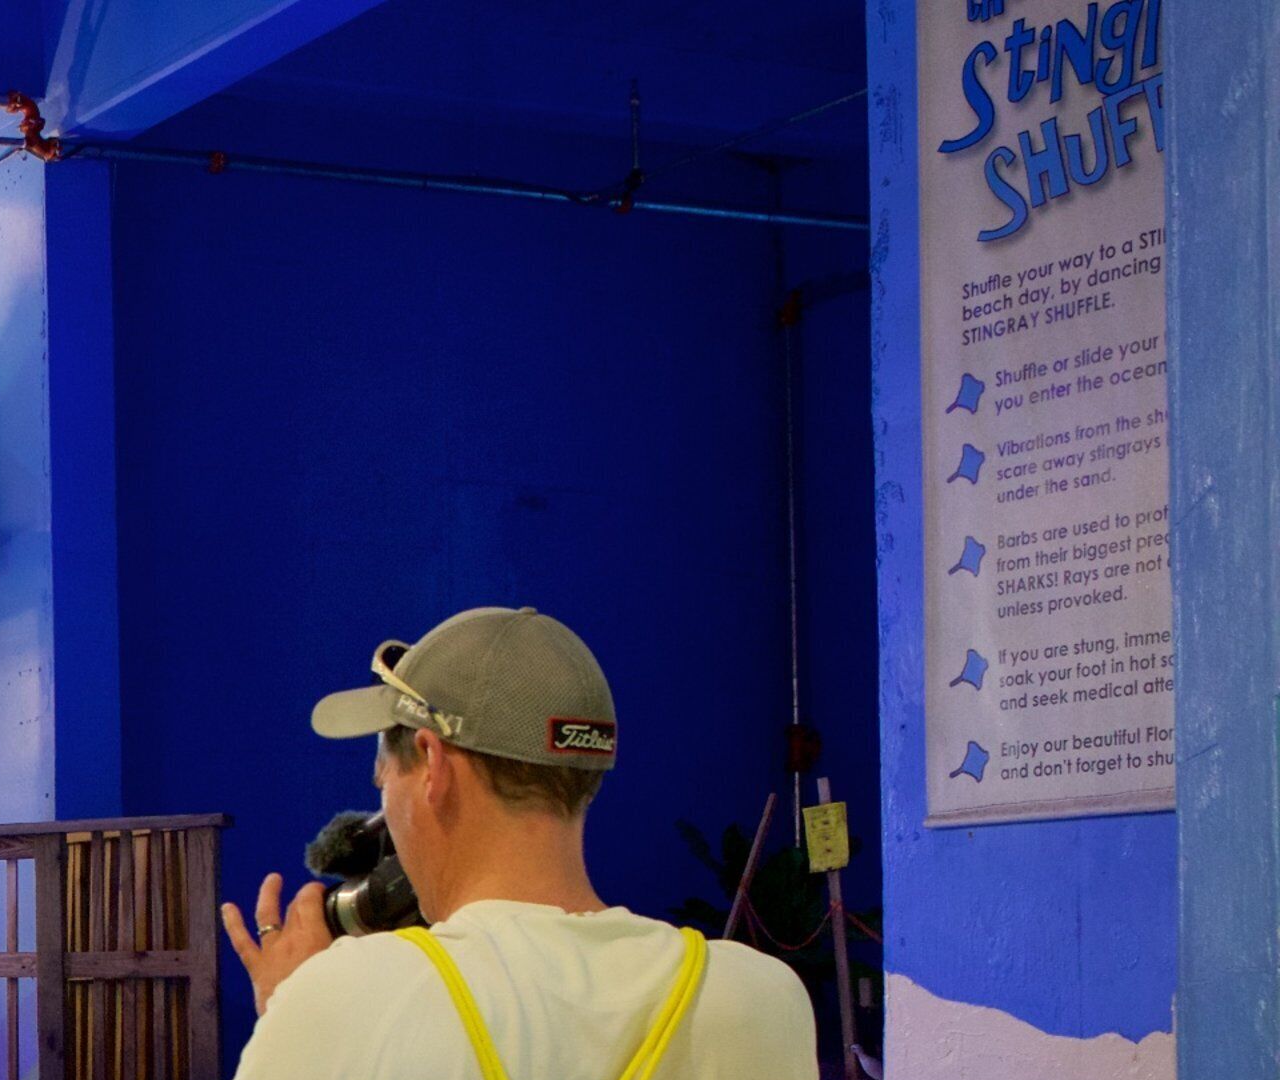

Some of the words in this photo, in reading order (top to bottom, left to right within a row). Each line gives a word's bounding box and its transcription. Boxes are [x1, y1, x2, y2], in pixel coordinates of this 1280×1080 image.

[962, 274, 1012, 299] Shuffle
[1017, 263, 1054, 288] your
[1058, 250, 1094, 271] way
[1099, 244, 1116, 261] to
[1122, 240, 1133, 254] a
[1139, 228, 1165, 249] STI
[962, 294, 1013, 321] beach
[1018, 284, 1055, 306] day,
[1060, 277, 1081, 295] by
[1087, 256, 1161, 287] dancing
[961, 311, 1040, 346] STINGRAY
[1045, 292, 1115, 324] SHUFFLE.
[995, 362, 1048, 387] Shuffle
[1053, 358, 1069, 373] or
[1074, 346, 1113, 369] slide
[1118, 335, 1158, 361] your
[995, 394, 1023, 416] you
[1028, 382, 1071, 404] enter
[1077, 376, 1104, 392] the
[996, 431, 1071, 457] Vibrations
[1075, 422, 1110, 441] from
[1115, 415, 1141, 432] the
[1147, 408, 1169, 426] sh
[997, 462, 1037, 481] scare
[1042, 451, 1085, 471] away
[1090, 436, 1161, 462] stingrays
[997, 484, 1040, 503] under
[1045, 478, 1068, 495] the
[1073, 467, 1116, 489] sand.
[997, 531, 1037, 549] Barbs
[1042, 527, 1067, 542] are
[1072, 515, 1110, 536] used
[1115, 512, 1130, 528] to
[997, 557, 1030, 573] from
[1035, 547, 1068, 566] their
[1072, 536, 1132, 561] biggest
[997, 571, 1058, 596] SHARKS!
[1064, 568, 1099, 586] Rays
[1104, 563, 1130, 578] are
[1136, 554, 1162, 573] not
[997, 601, 1043, 619] unless
[1048, 585, 1128, 615] provoked.
[998, 649, 1006, 664] If
[1010, 649, 1039, 667] you
[1043, 644, 1069, 659] are
[1073, 638, 1119, 655] stung,
[999, 669, 1035, 688] soak
[1038, 667, 1072, 686] your
[1075, 662, 1106, 678] foot
[1111, 658, 1124, 674] in
[1130, 654, 1156, 672] hot
[999, 693, 1028, 711] and
[1032, 689, 1069, 708] seek
[1073, 680, 1138, 702] medical
[1000, 741, 1039, 759] Enjoy
[1043, 739, 1068, 753] our
[1072, 728, 1141, 750] beautiful
[1000, 763, 1028, 780] and
[1033, 759, 1072, 777] don't
[1075, 755, 1122, 775] forget
[1127, 753, 1141, 768] to
